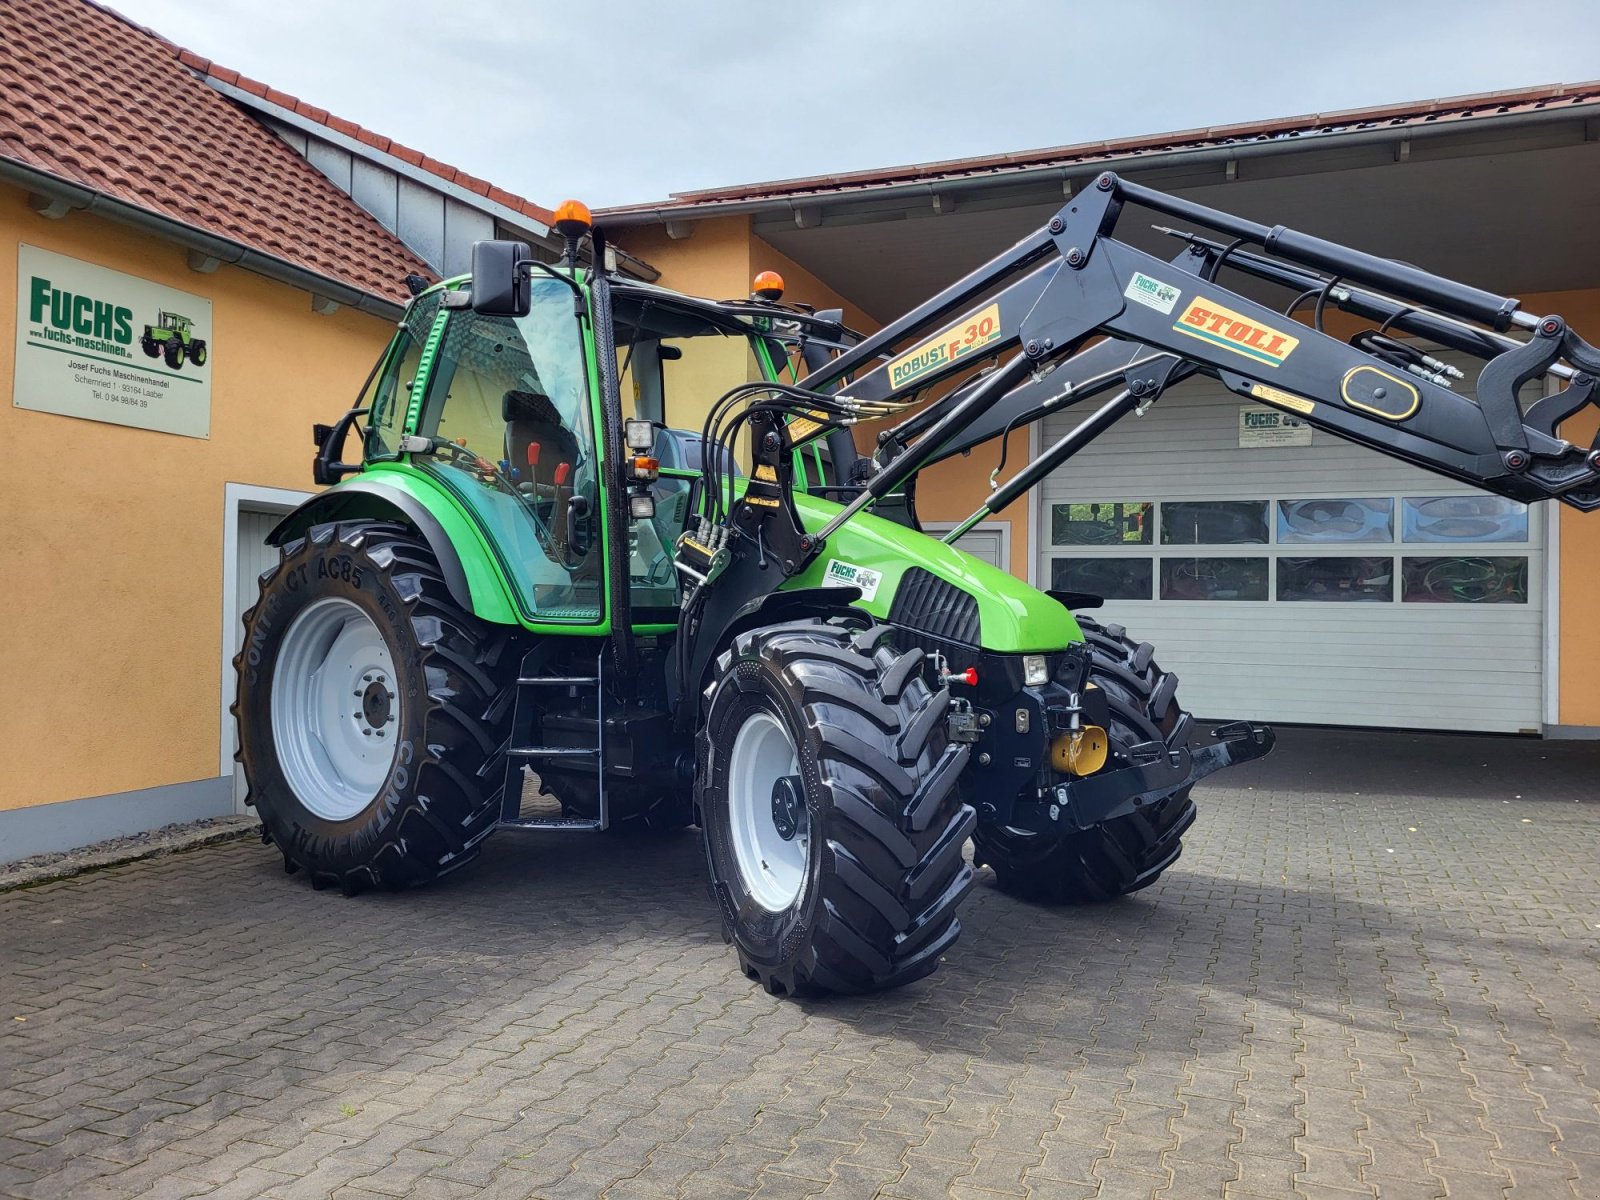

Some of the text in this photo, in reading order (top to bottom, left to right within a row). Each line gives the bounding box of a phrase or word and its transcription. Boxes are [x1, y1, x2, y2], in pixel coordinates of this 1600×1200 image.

[1134, 274, 1159, 293] FUCHS
[30, 276, 133, 345] FUCHS
[1185, 306, 1287, 357] STOLL
[893, 343, 946, 382] ROBUST
[949, 340, 961, 361] F
[964, 317, 993, 344] 30
[68, 360, 170, 389] Josef Fuchs Maschinenhandel
[122, 384, 141, 394] 93164
[1245, 412, 1280, 426] FUCHS
[317, 557, 364, 590] AC85
[830, 561, 857, 578] FUCHS
